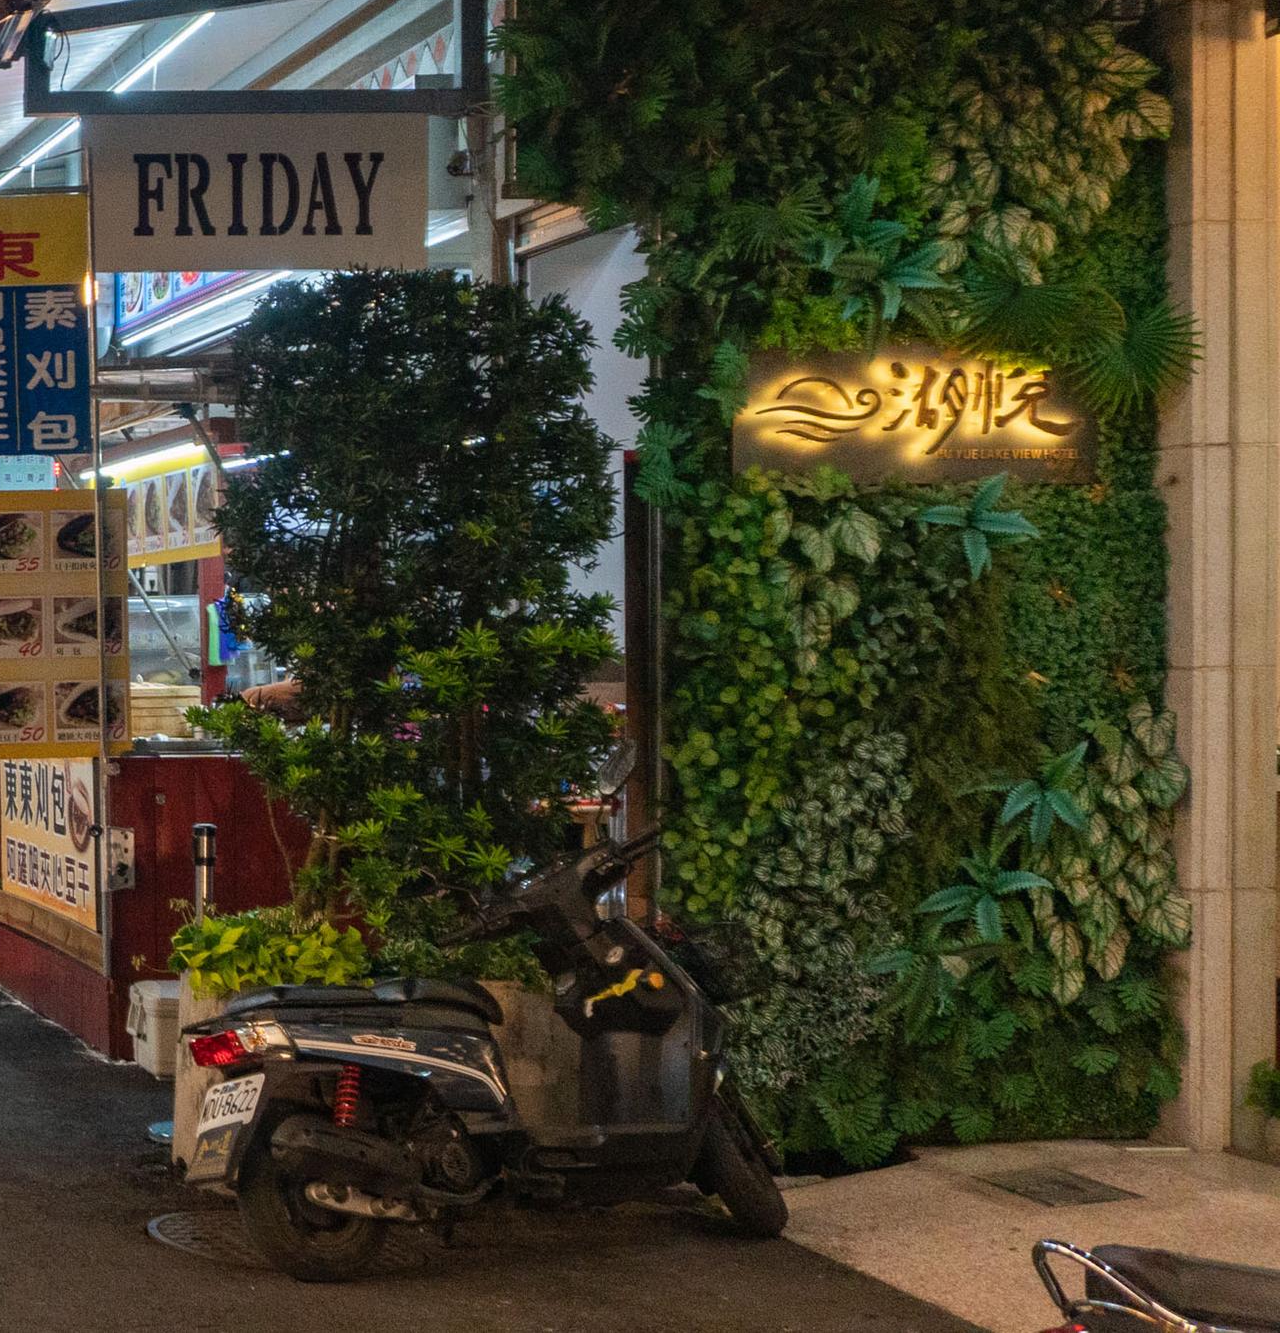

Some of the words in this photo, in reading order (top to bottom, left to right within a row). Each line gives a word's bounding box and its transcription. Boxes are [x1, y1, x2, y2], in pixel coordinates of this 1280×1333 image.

[133, 152, 385, 236] FRIDAY
[24, 290, 80, 451] 素刈包
[981, 448, 1010, 459] LAKE
[1011, 448, 1042, 459] VIEW
[1044, 448, 1079, 459] HOTEL
[15, 557, 40, 572] 35
[19, 642, 42, 656] 40
[20, 726, 44, 741] 50
[4, 758, 66, 836] 東東刈包
